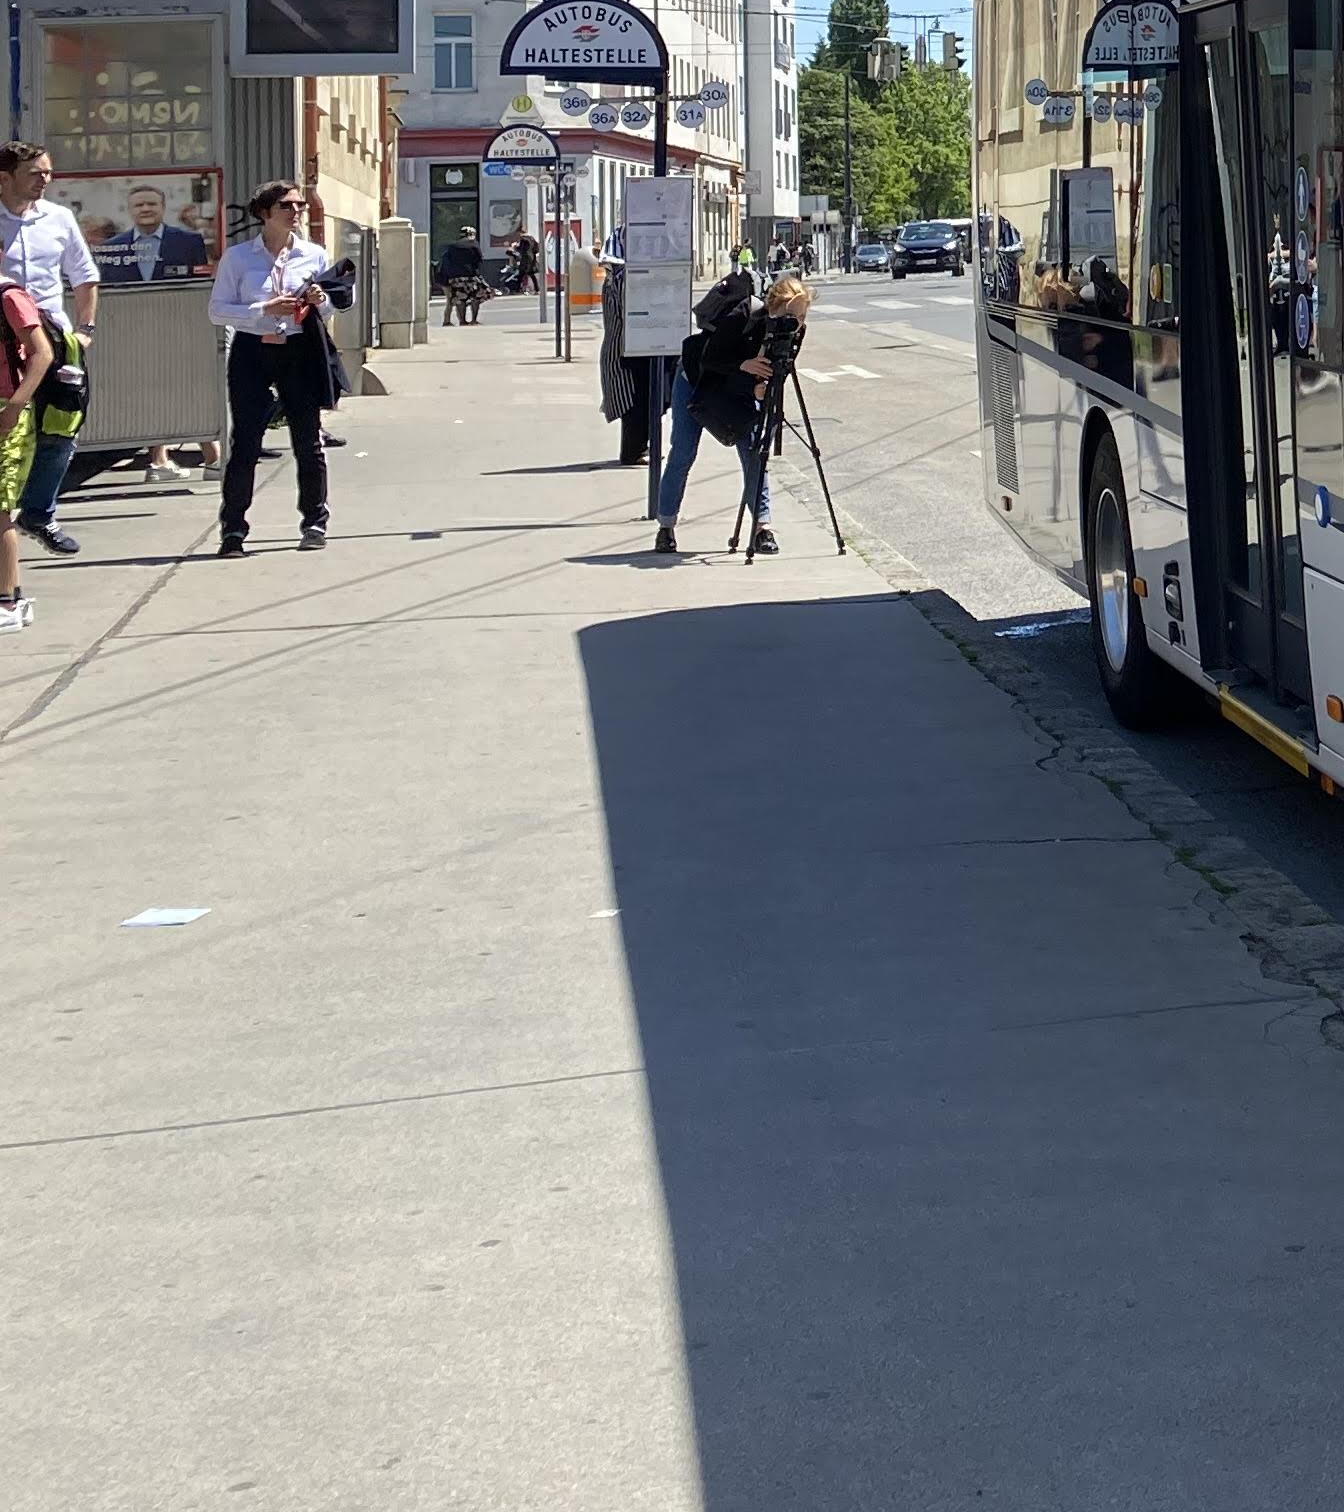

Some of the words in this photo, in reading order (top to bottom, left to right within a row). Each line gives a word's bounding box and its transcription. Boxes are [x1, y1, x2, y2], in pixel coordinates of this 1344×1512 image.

[543, 5, 633, 33] AUTOBUS
[525, 48, 647, 64] HALTESTELLE
[702, 89, 727, 100] 30A
[563, 96, 588, 108] 36B
[591, 113, 616, 125] 36A
[623, 110, 648, 123] 32A
[679, 109, 703, 120] 31A
[501, 130, 544, 143] AUTOBUS
[493, 148, 551, 157] HALTESTELLE
